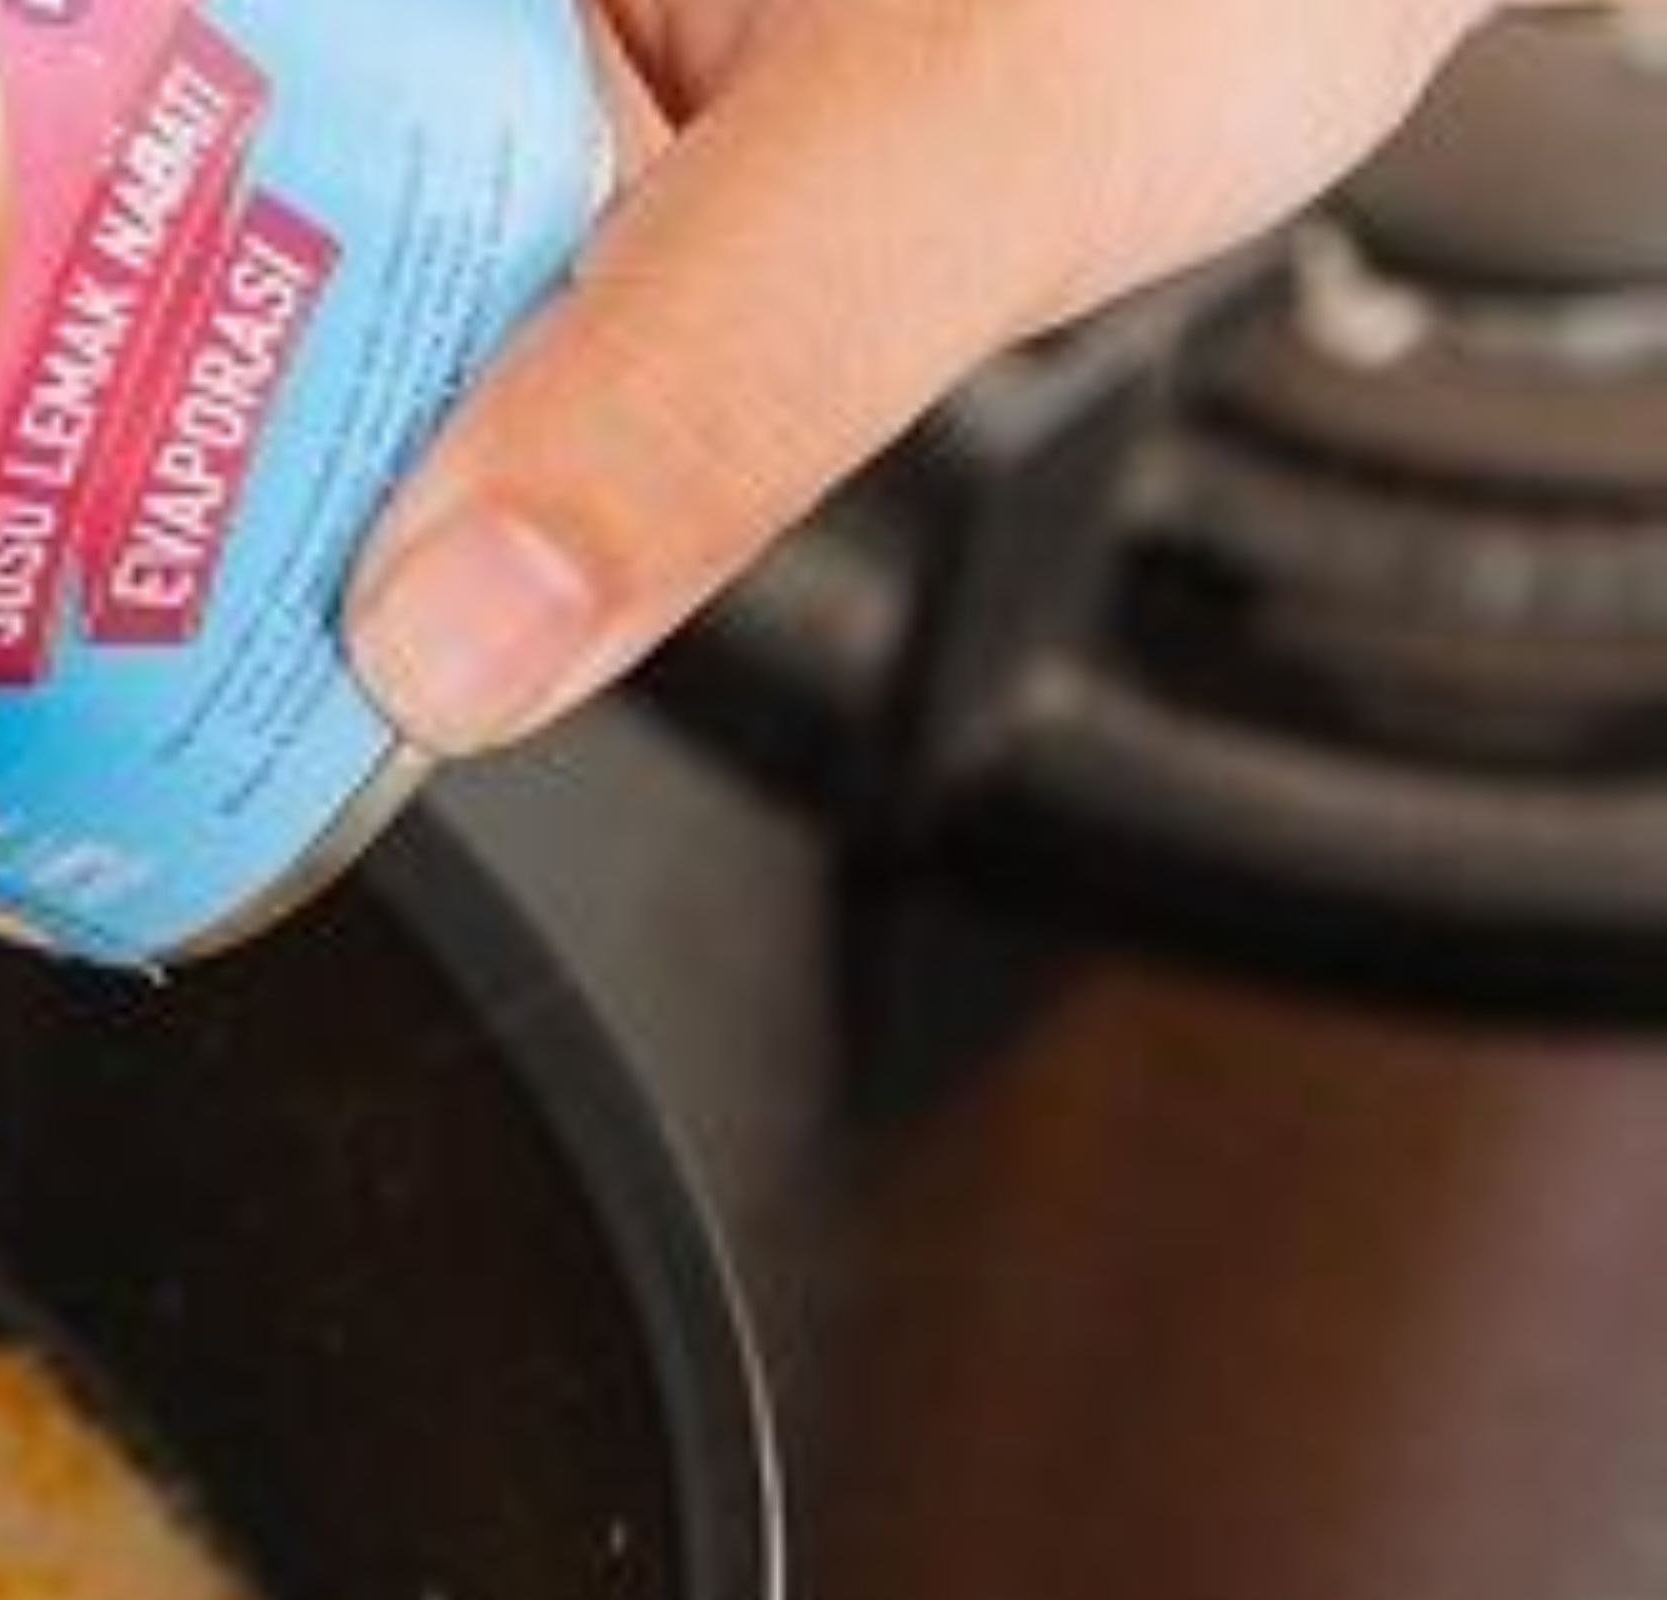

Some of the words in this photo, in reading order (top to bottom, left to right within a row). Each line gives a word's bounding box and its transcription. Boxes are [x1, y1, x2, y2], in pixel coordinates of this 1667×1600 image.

[3, 272, 135, 490] LEMAK
[91, 58, 227, 268] NABATI
[109, 234, 307, 609] EVAPORASI
